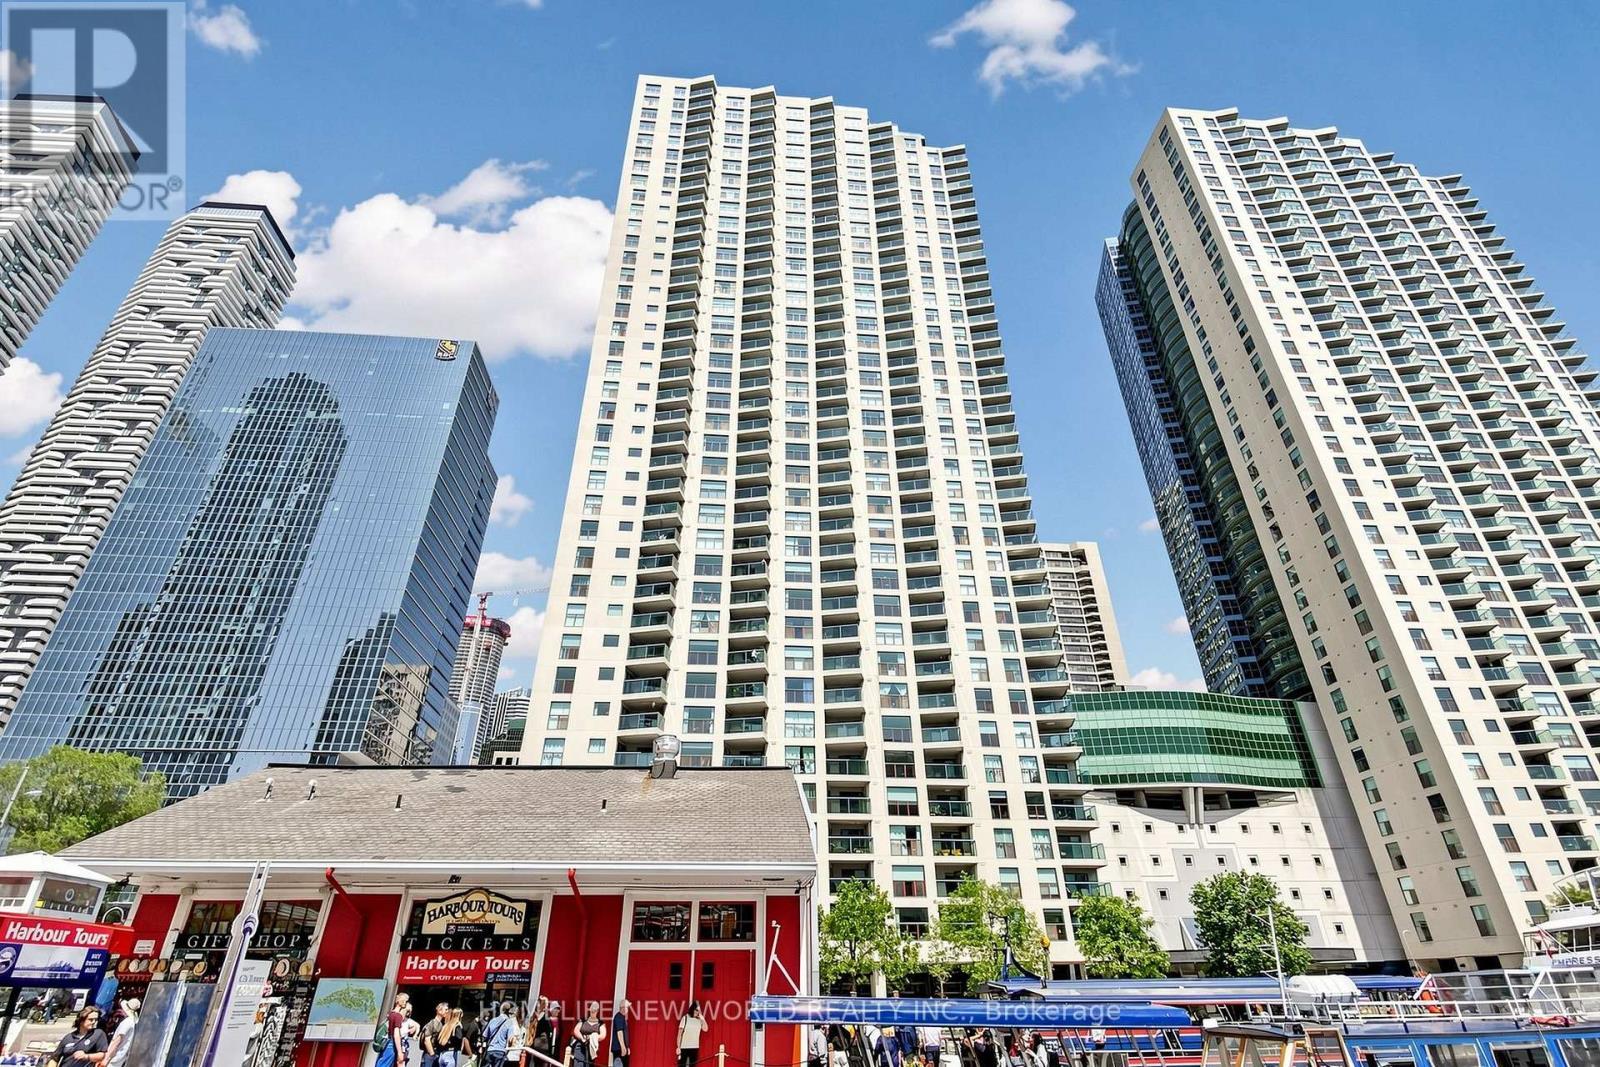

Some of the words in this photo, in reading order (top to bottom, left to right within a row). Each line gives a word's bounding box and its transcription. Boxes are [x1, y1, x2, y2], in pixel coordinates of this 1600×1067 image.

[427, 900, 487, 924] HARBOUR
[488, 899, 523, 925] TOURS
[5, 921, 70, 943] Harbour
[74, 927, 109, 946] Tours
[187, 934, 232, 948] GIFT
[249, 935, 300, 947] HOP
[406, 938, 530, 950] TICKETS
[405, 955, 480, 970] Harbour
[484, 956, 530, 970] Tours
